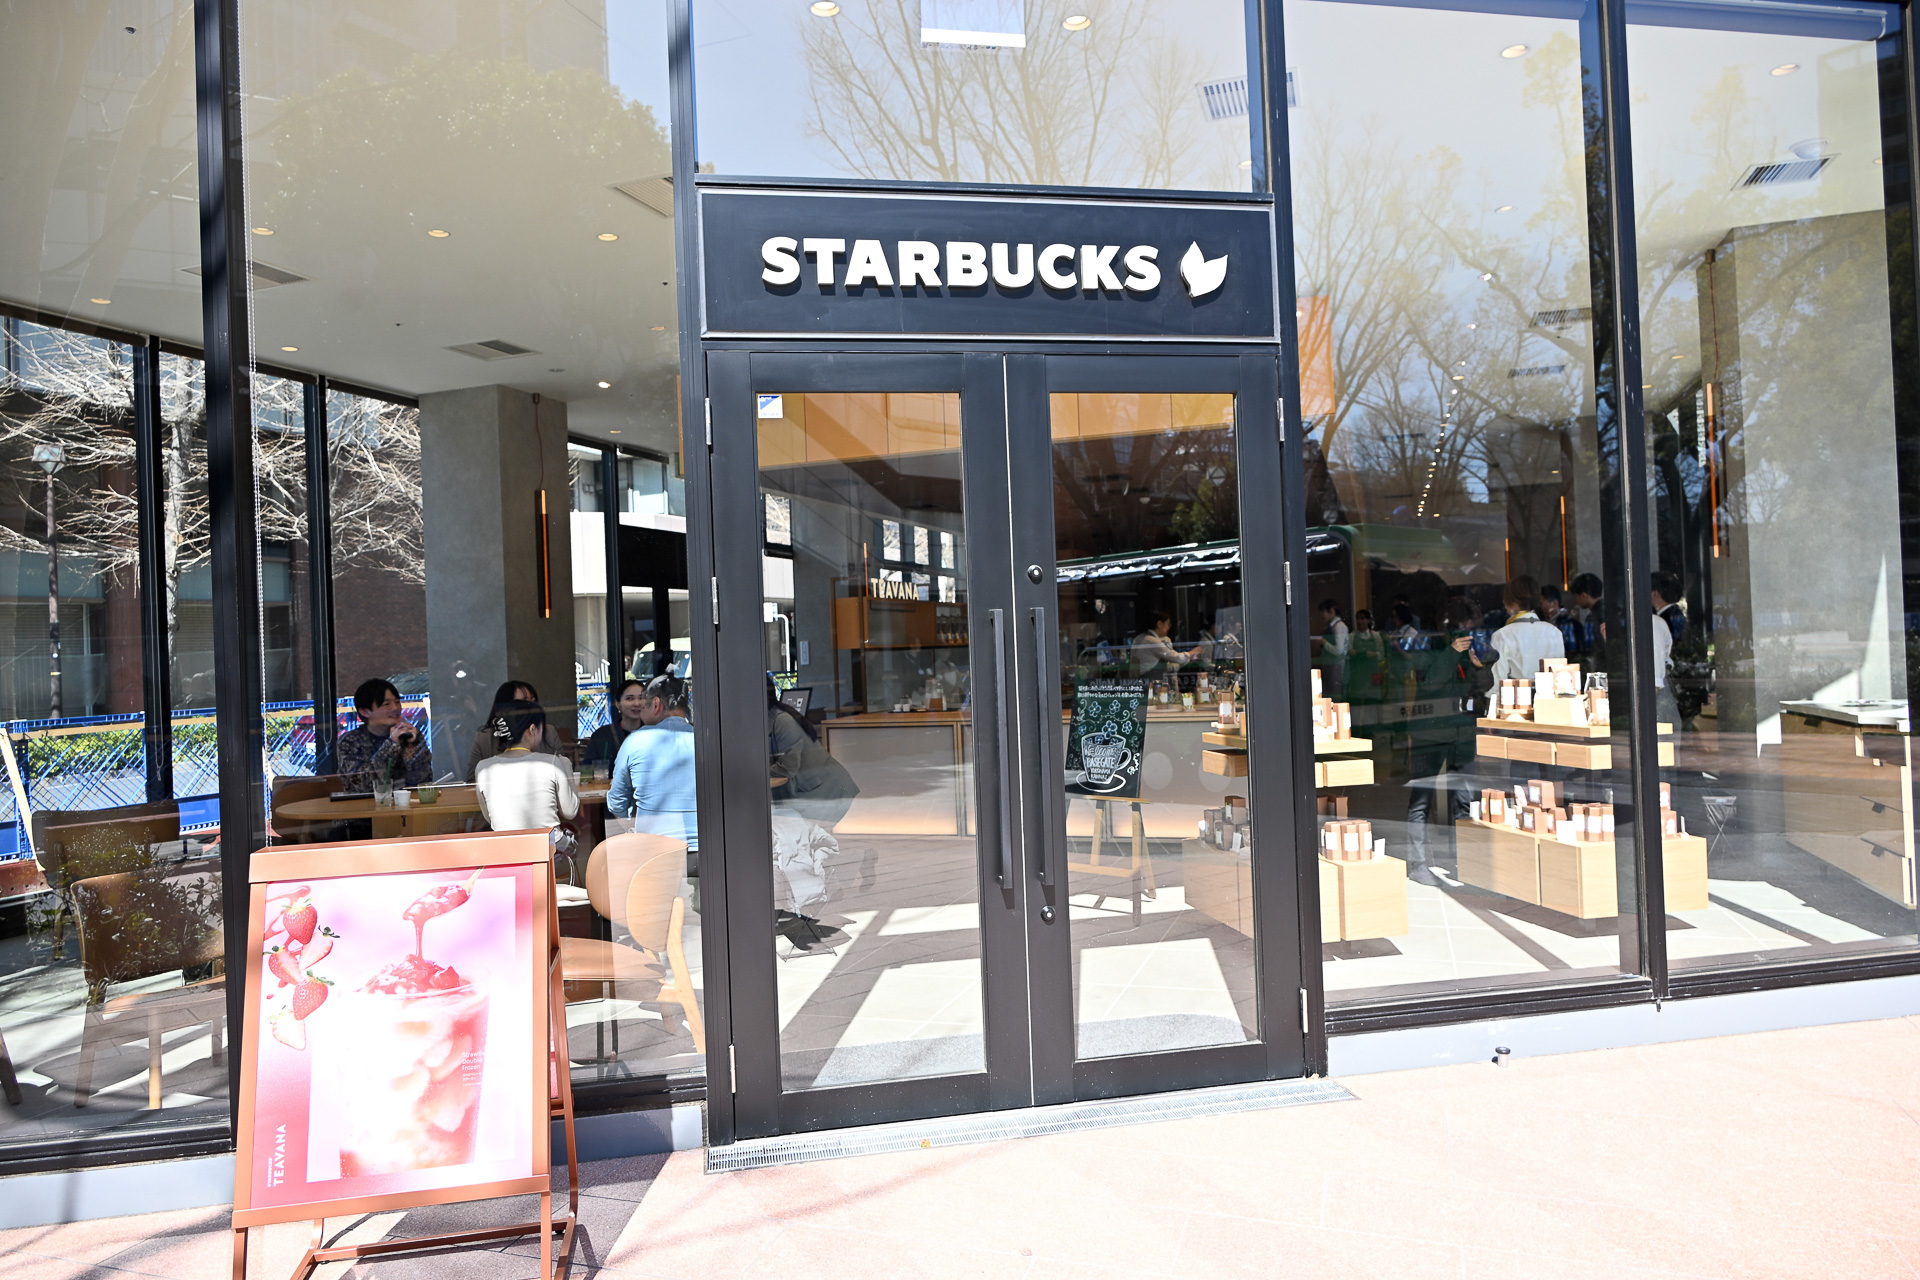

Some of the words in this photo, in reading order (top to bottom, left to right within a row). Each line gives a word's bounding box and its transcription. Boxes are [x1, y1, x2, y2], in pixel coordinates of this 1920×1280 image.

[760, 236, 1161, 292] STARBUCKS
[870, 577, 919, 600] TEAVANA
[1086, 757, 1115, 768] BASEGATE
[273, 1123, 287, 1187] TEAVANA
